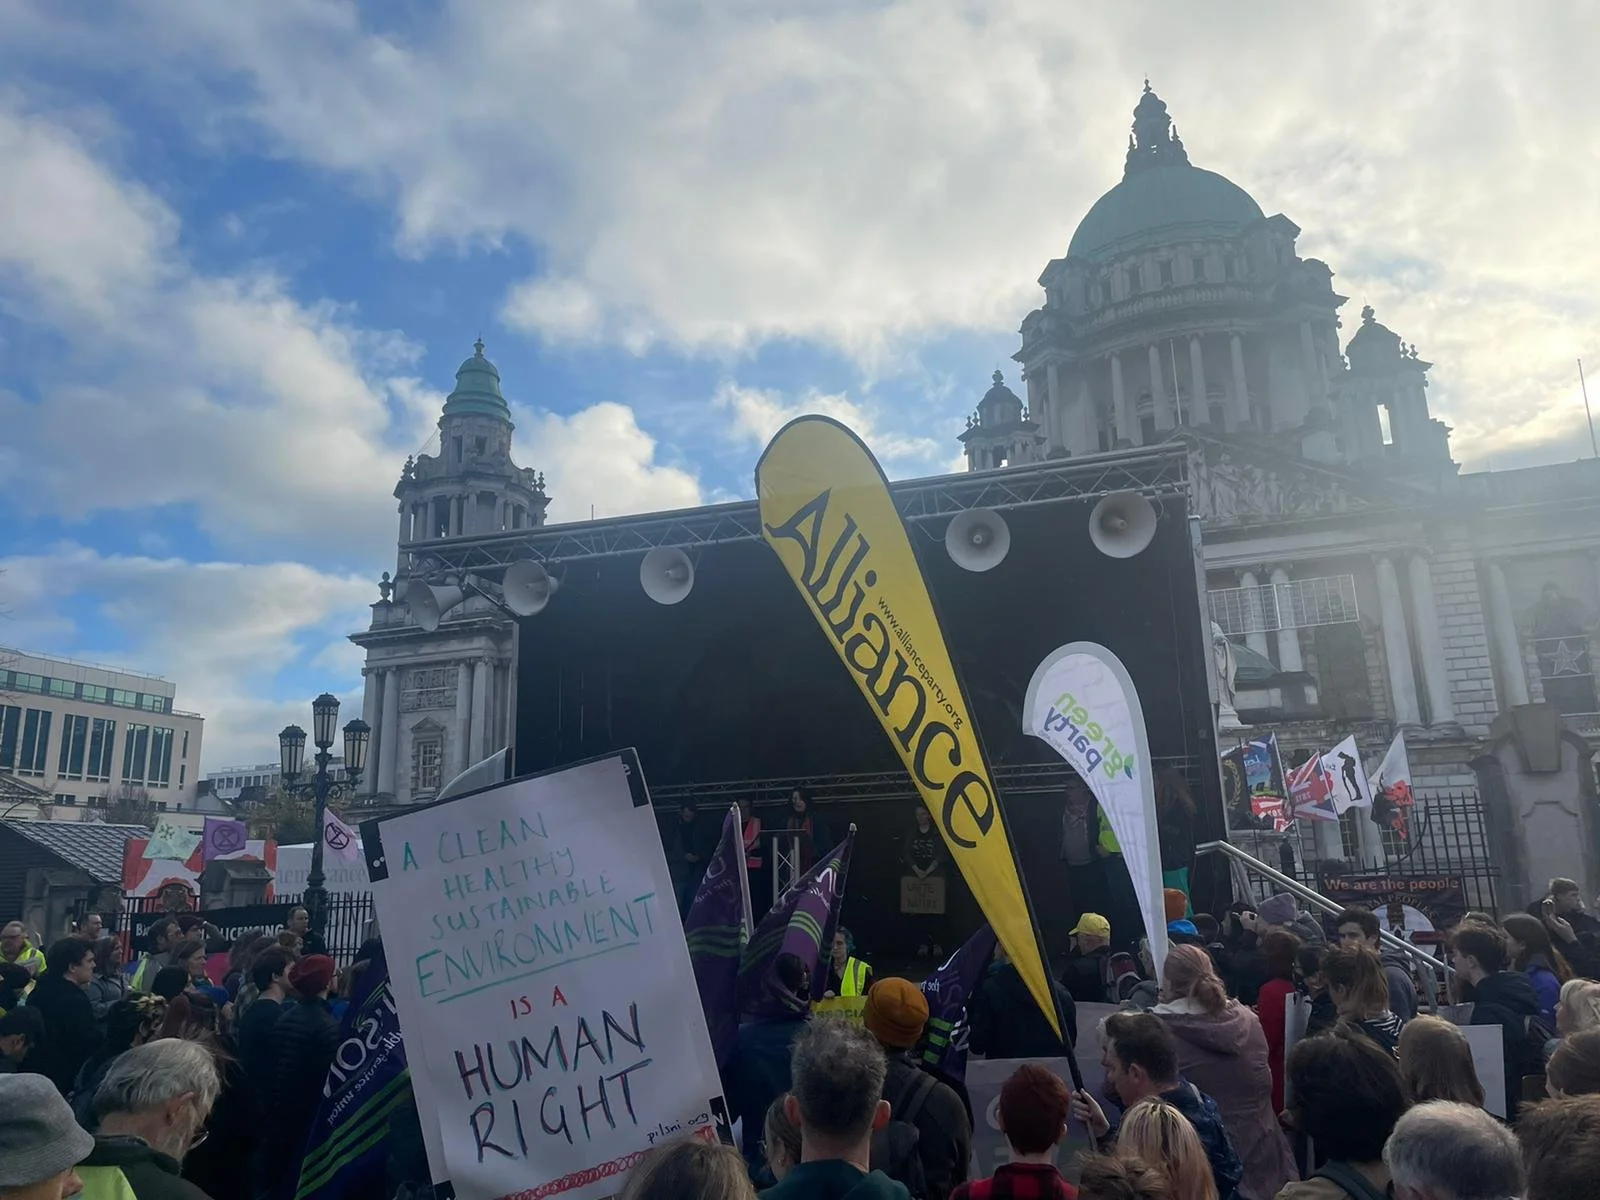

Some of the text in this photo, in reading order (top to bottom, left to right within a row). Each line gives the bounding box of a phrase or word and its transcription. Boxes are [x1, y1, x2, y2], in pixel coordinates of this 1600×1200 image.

[764, 488, 995, 849] Alliance
[877, 596, 964, 731] www.allianceparty.org
[402, 812, 549, 870] A CLEAN
[443, 847, 576, 899] HEALTHY
[431, 870, 616, 941] SUSTAINABLE
[1325, 878, 1459, 892] We are the people
[416, 893, 655, 998] ENVIRONMENT
[510, 985, 569, 1019] IS A
[454, 1001, 647, 1100] HUMAN
[469, 1058, 654, 1163] RIGHT
